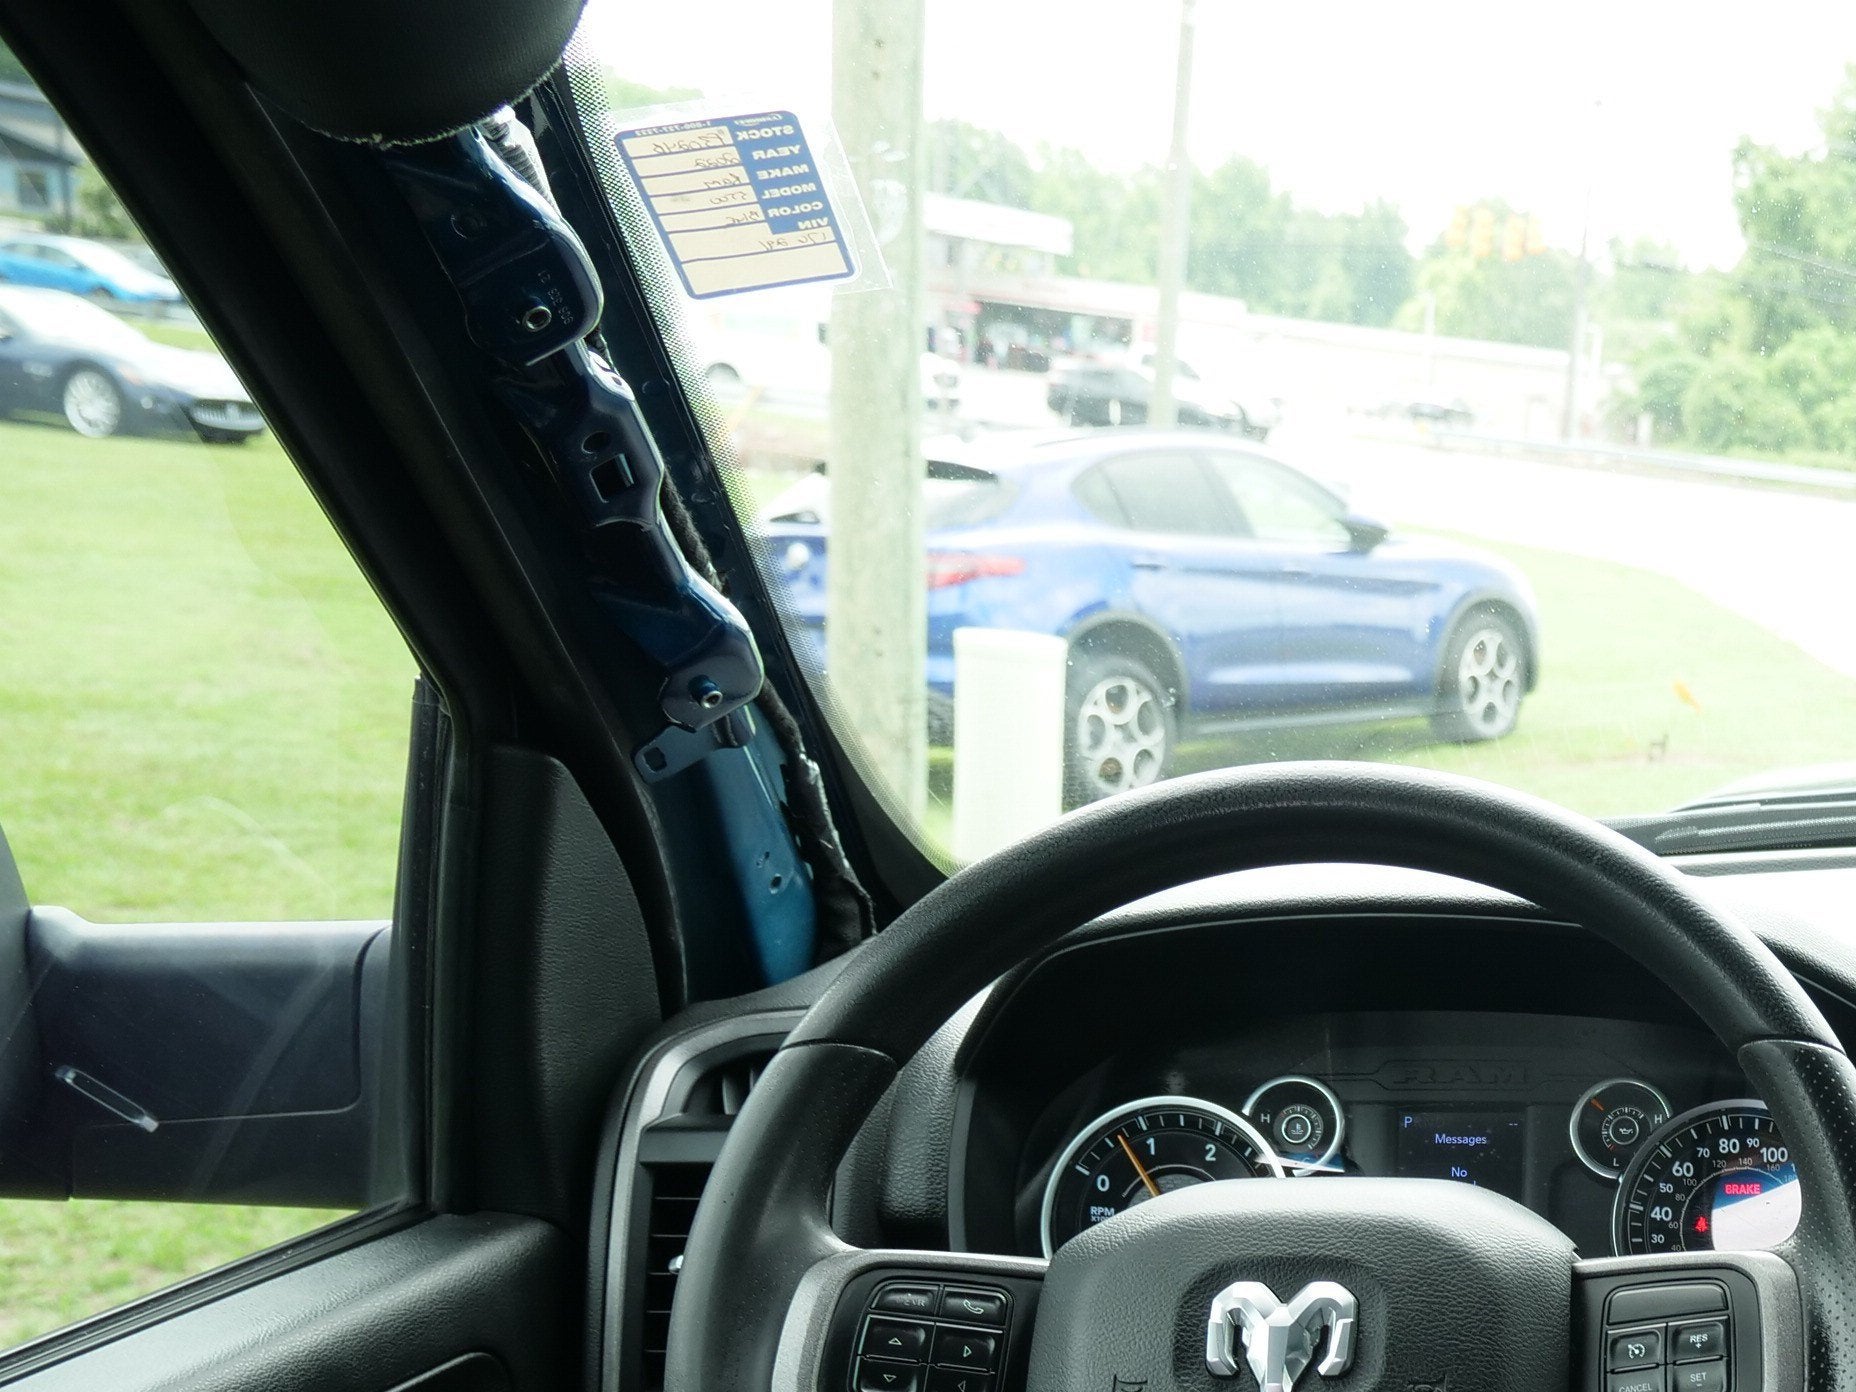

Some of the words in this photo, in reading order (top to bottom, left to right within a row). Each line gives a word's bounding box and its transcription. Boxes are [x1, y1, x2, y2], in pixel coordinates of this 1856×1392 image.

[1261, 1113, 1270, 1123] H
[1404, 1116, 1413, 1128] P
[1655, 1114, 1663, 1124] H
[1435, 1133, 1487, 1146] Messages
[1746, 1138, 1760, 1148] 90
[1146, 1138, 1156, 1156] 1
[1718, 1138, 1740, 1154] 80
[1205, 1144, 1217, 1161] 2
[1696, 1147, 1710, 1158] 70
[1760, 1147, 1788, 1163] 100
[1613, 1158, 1620, 1167] L
[1712, 1159, 1727, 1168] 120
[1738, 1157, 1753, 1166] 140
[1451, 1167, 1468, 1178] No
[1672, 1161, 1694, 1177] 60
[1766, 1163, 1781, 1172] 160
[1096, 1175, 1110, 1192] 0
[1659, 1182, 1674, 1193] 50
[1683, 1178, 1697, 1187] 100
[1725, 1183, 1761, 1195] BRAKE
[1675, 1193, 1685, 1201] 80
[1090, 1205, 1115, 1217] RPM
[1651, 1206, 1672, 1221] 40
[1668, 1221, 1679, 1230] 60
[1651, 1234, 1665, 1244] 30
[1689, 1333, 1708, 1344] RES
[1690, 1372, 1707, 1383] SET
